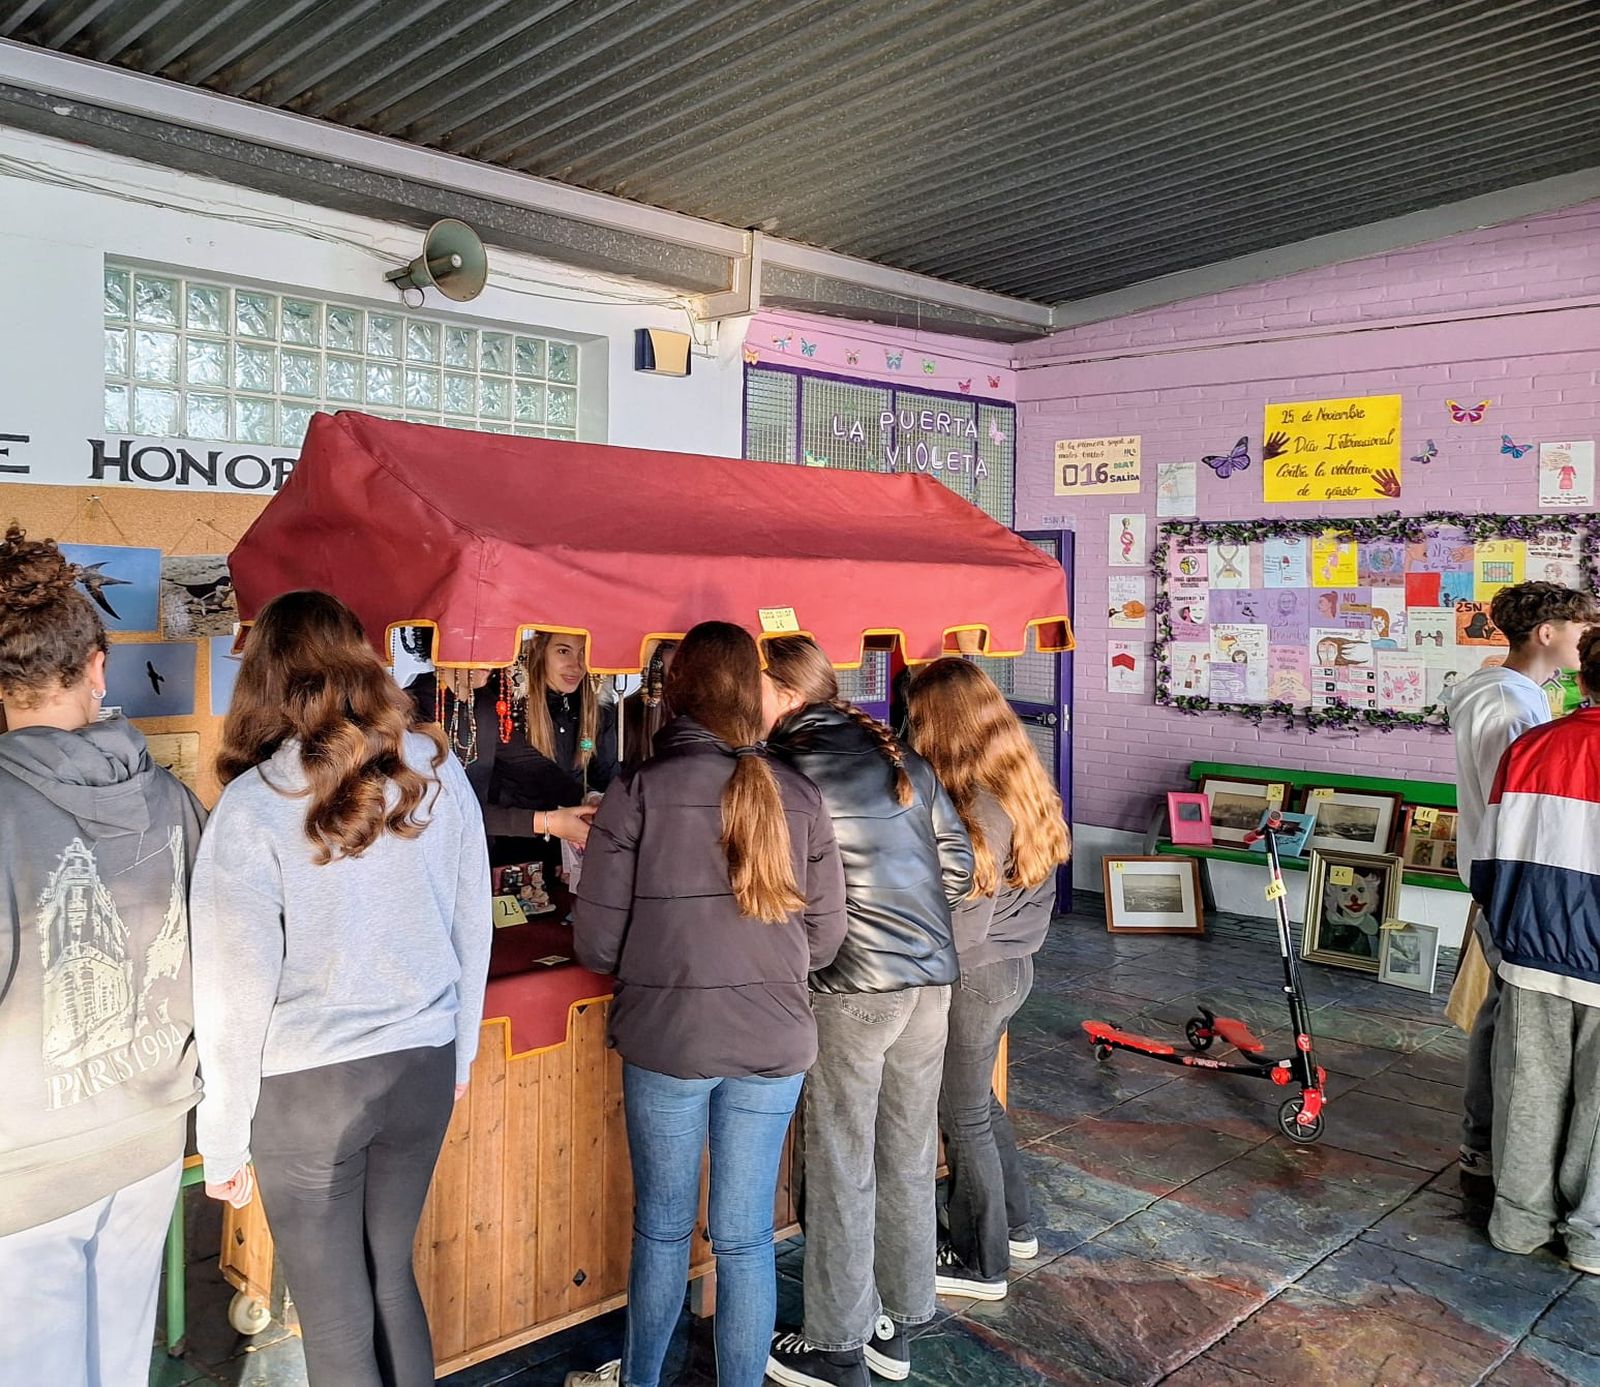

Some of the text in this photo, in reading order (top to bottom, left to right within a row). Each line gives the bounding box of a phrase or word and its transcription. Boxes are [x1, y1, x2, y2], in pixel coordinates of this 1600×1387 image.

[832, 409, 979, 443] LA PUERTA
[1281, 408, 1295, 424] 25
[1301, 410, 1313, 422] de
[885, 436, 989, 478] VIOLETA
[1062, 462, 1110, 487] 016
[1109, 473, 1140, 483] SALIDA
[1296, 483, 1311, 497] de
[1456, 602, 1483, 613] 25N
[44, 1023, 186, 1111] PARIS 1994
